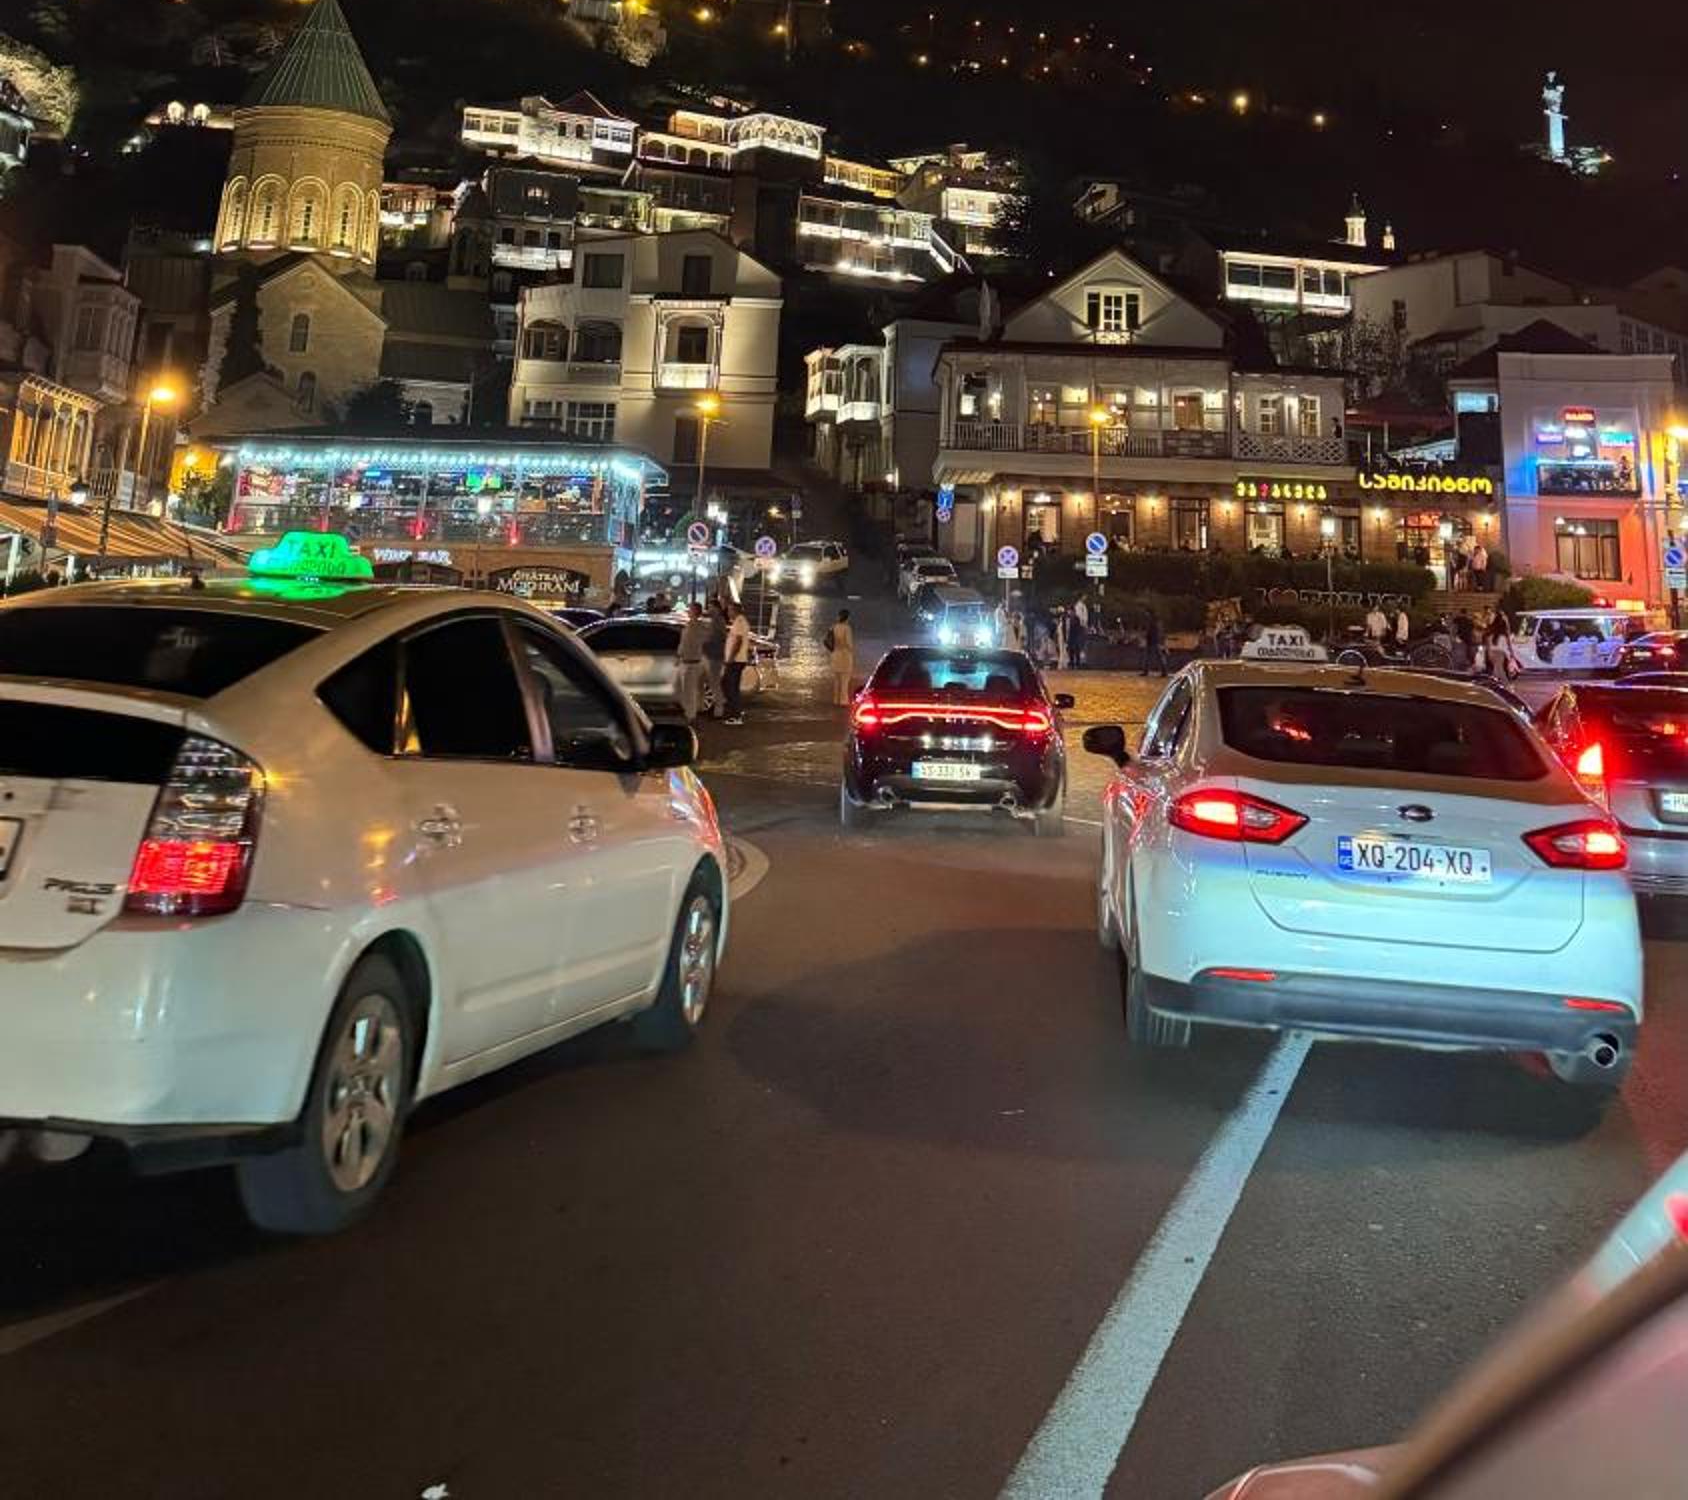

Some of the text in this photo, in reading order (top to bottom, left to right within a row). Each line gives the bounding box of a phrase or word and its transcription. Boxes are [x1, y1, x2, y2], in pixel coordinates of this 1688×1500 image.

[287, 539, 337, 559] TAXI
[1267, 632, 1304, 647] TAXI
[1356, 843, 1473, 875] XQ-204-XQ
